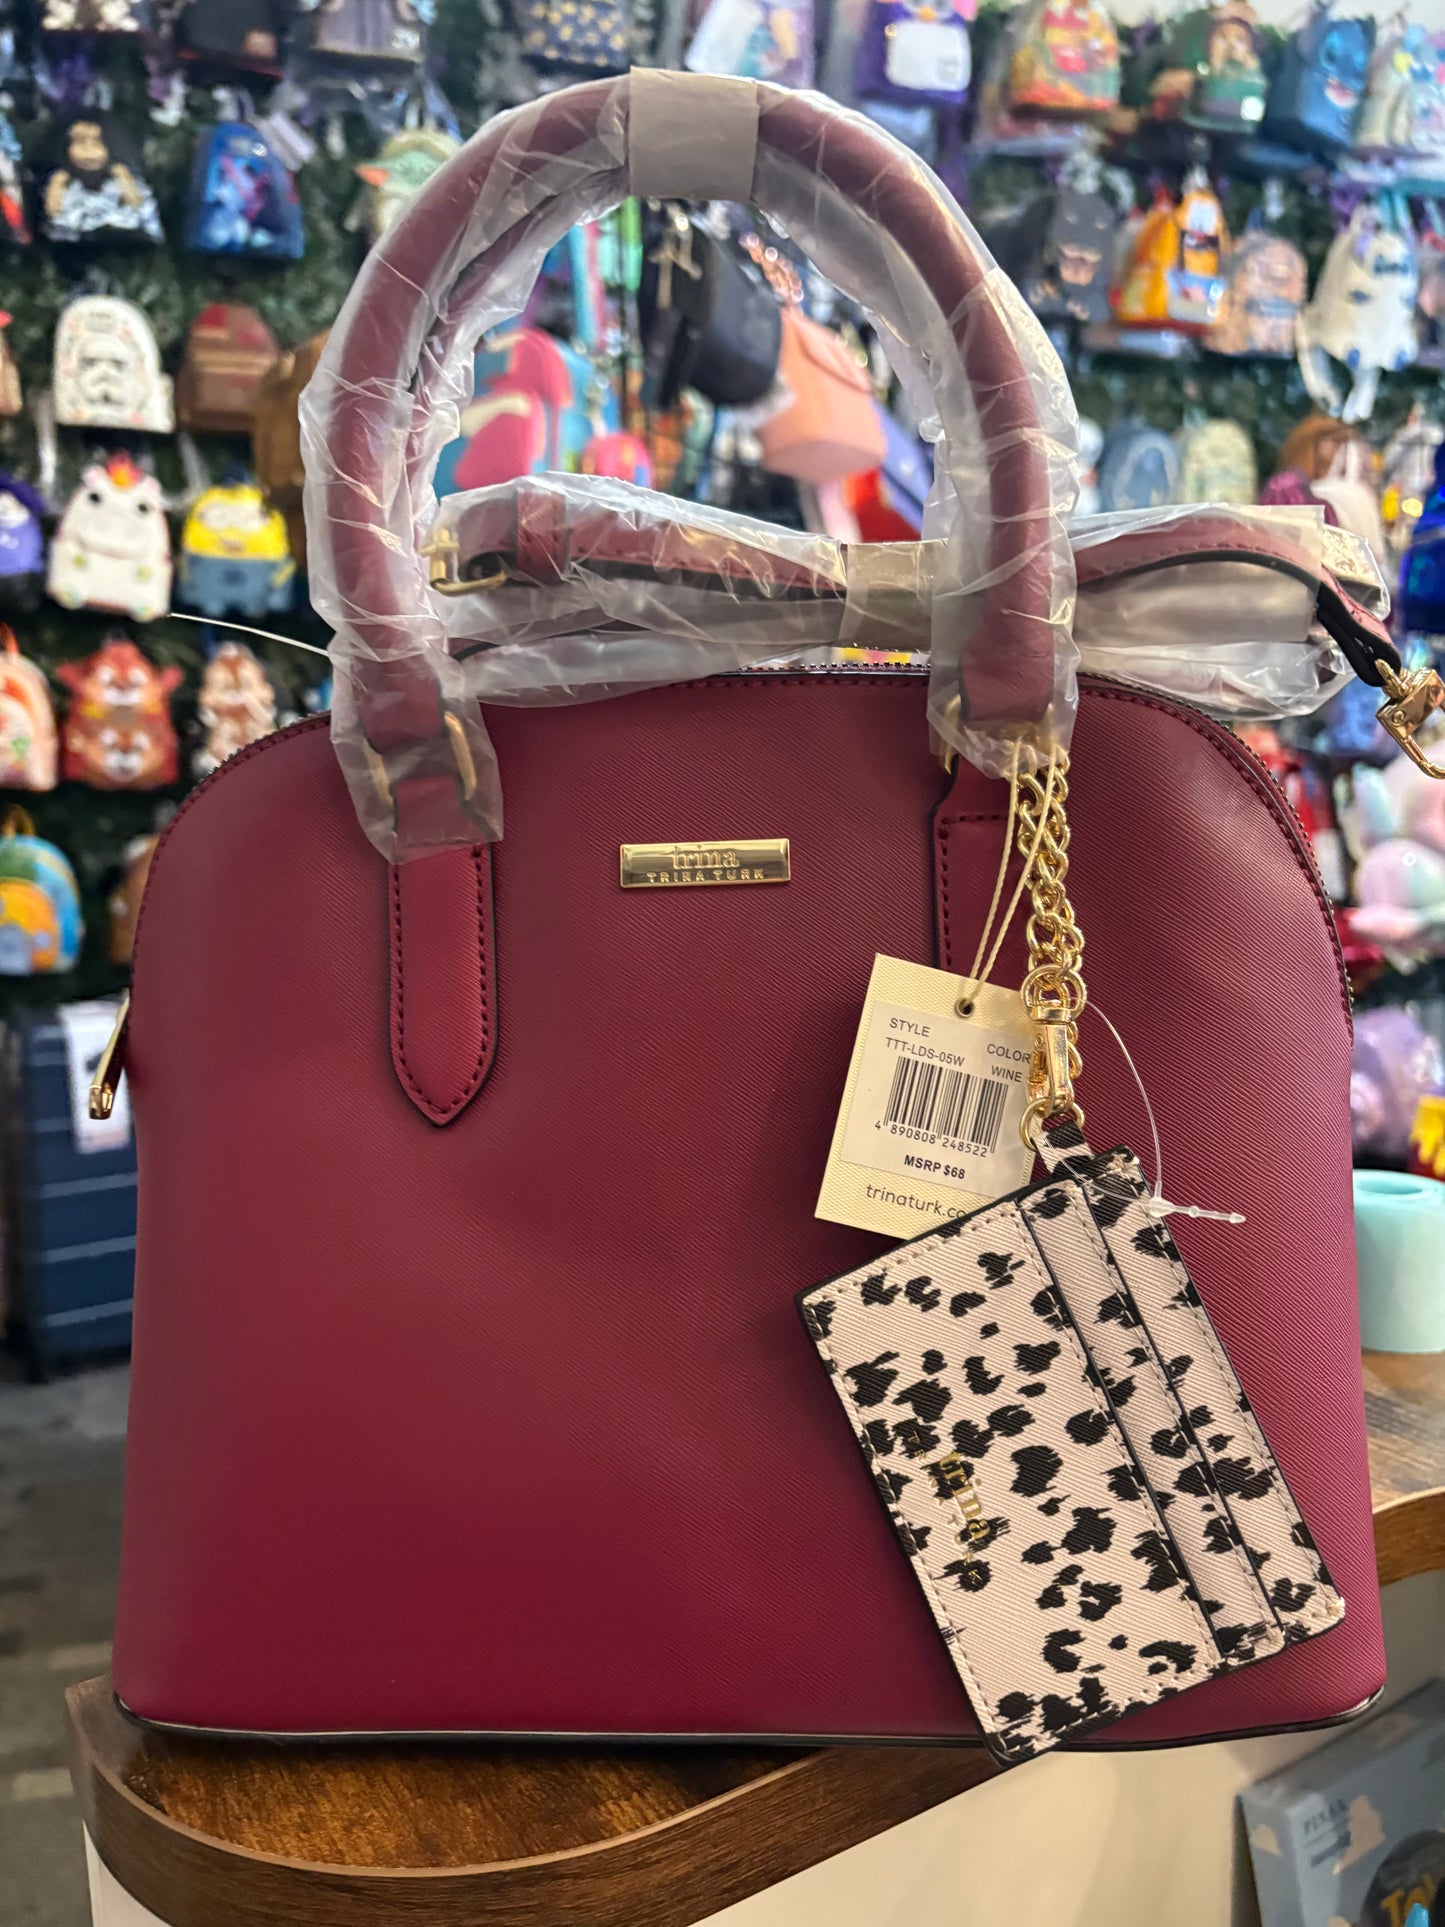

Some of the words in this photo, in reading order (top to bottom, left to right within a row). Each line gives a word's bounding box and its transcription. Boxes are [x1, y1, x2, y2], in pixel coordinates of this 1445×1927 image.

[672, 845, 740, 869] trina
[647, 870, 705, 883] TRINA
[713, 868, 764, 881] TURK
[889, 1017, 931, 1038] STYLE
[885, 1037, 965, 1067] TTT-LDS-05W
[987, 1043, 1031, 1065] COLOR
[991, 1064, 1023, 1083] WINE
[874, 1121, 882, 1131] 4
[890, 1124, 936, 1145] 890808
[942, 1138, 988, 1158] 248522
[904, 1154, 942, 1173] MSRP
[943, 1165, 966, 1180] $68
[866, 1184, 968, 1219] trinaturk.co
